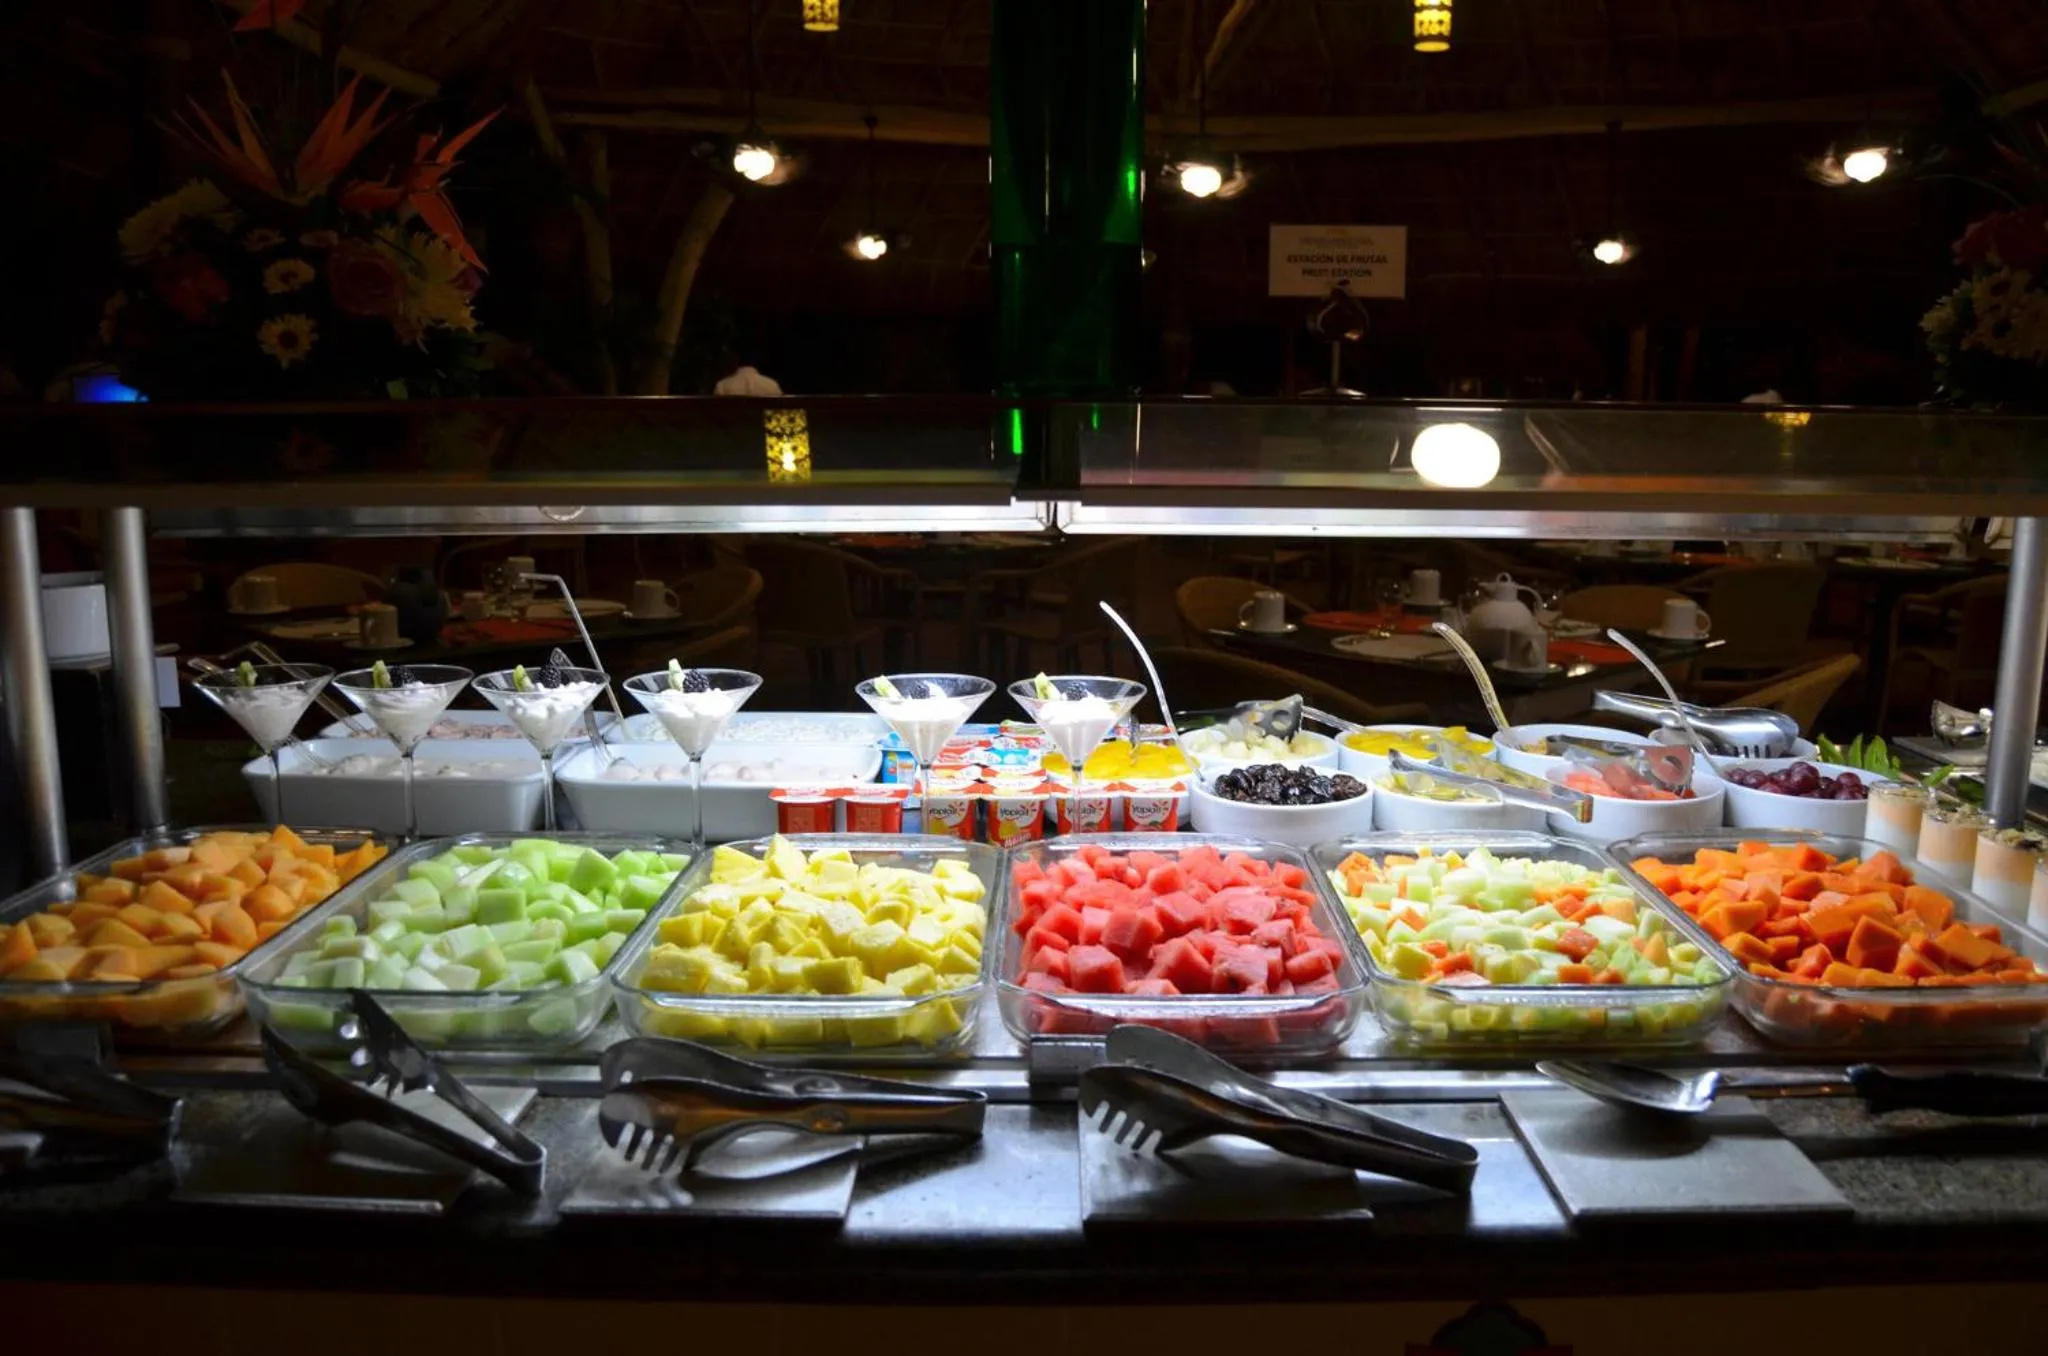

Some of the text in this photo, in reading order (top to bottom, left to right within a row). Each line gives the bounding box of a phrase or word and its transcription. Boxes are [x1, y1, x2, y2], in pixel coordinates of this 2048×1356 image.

[1351, 253, 1388, 264] FRUTAS
[1301, 267, 1372, 278] FRUIT STATION
